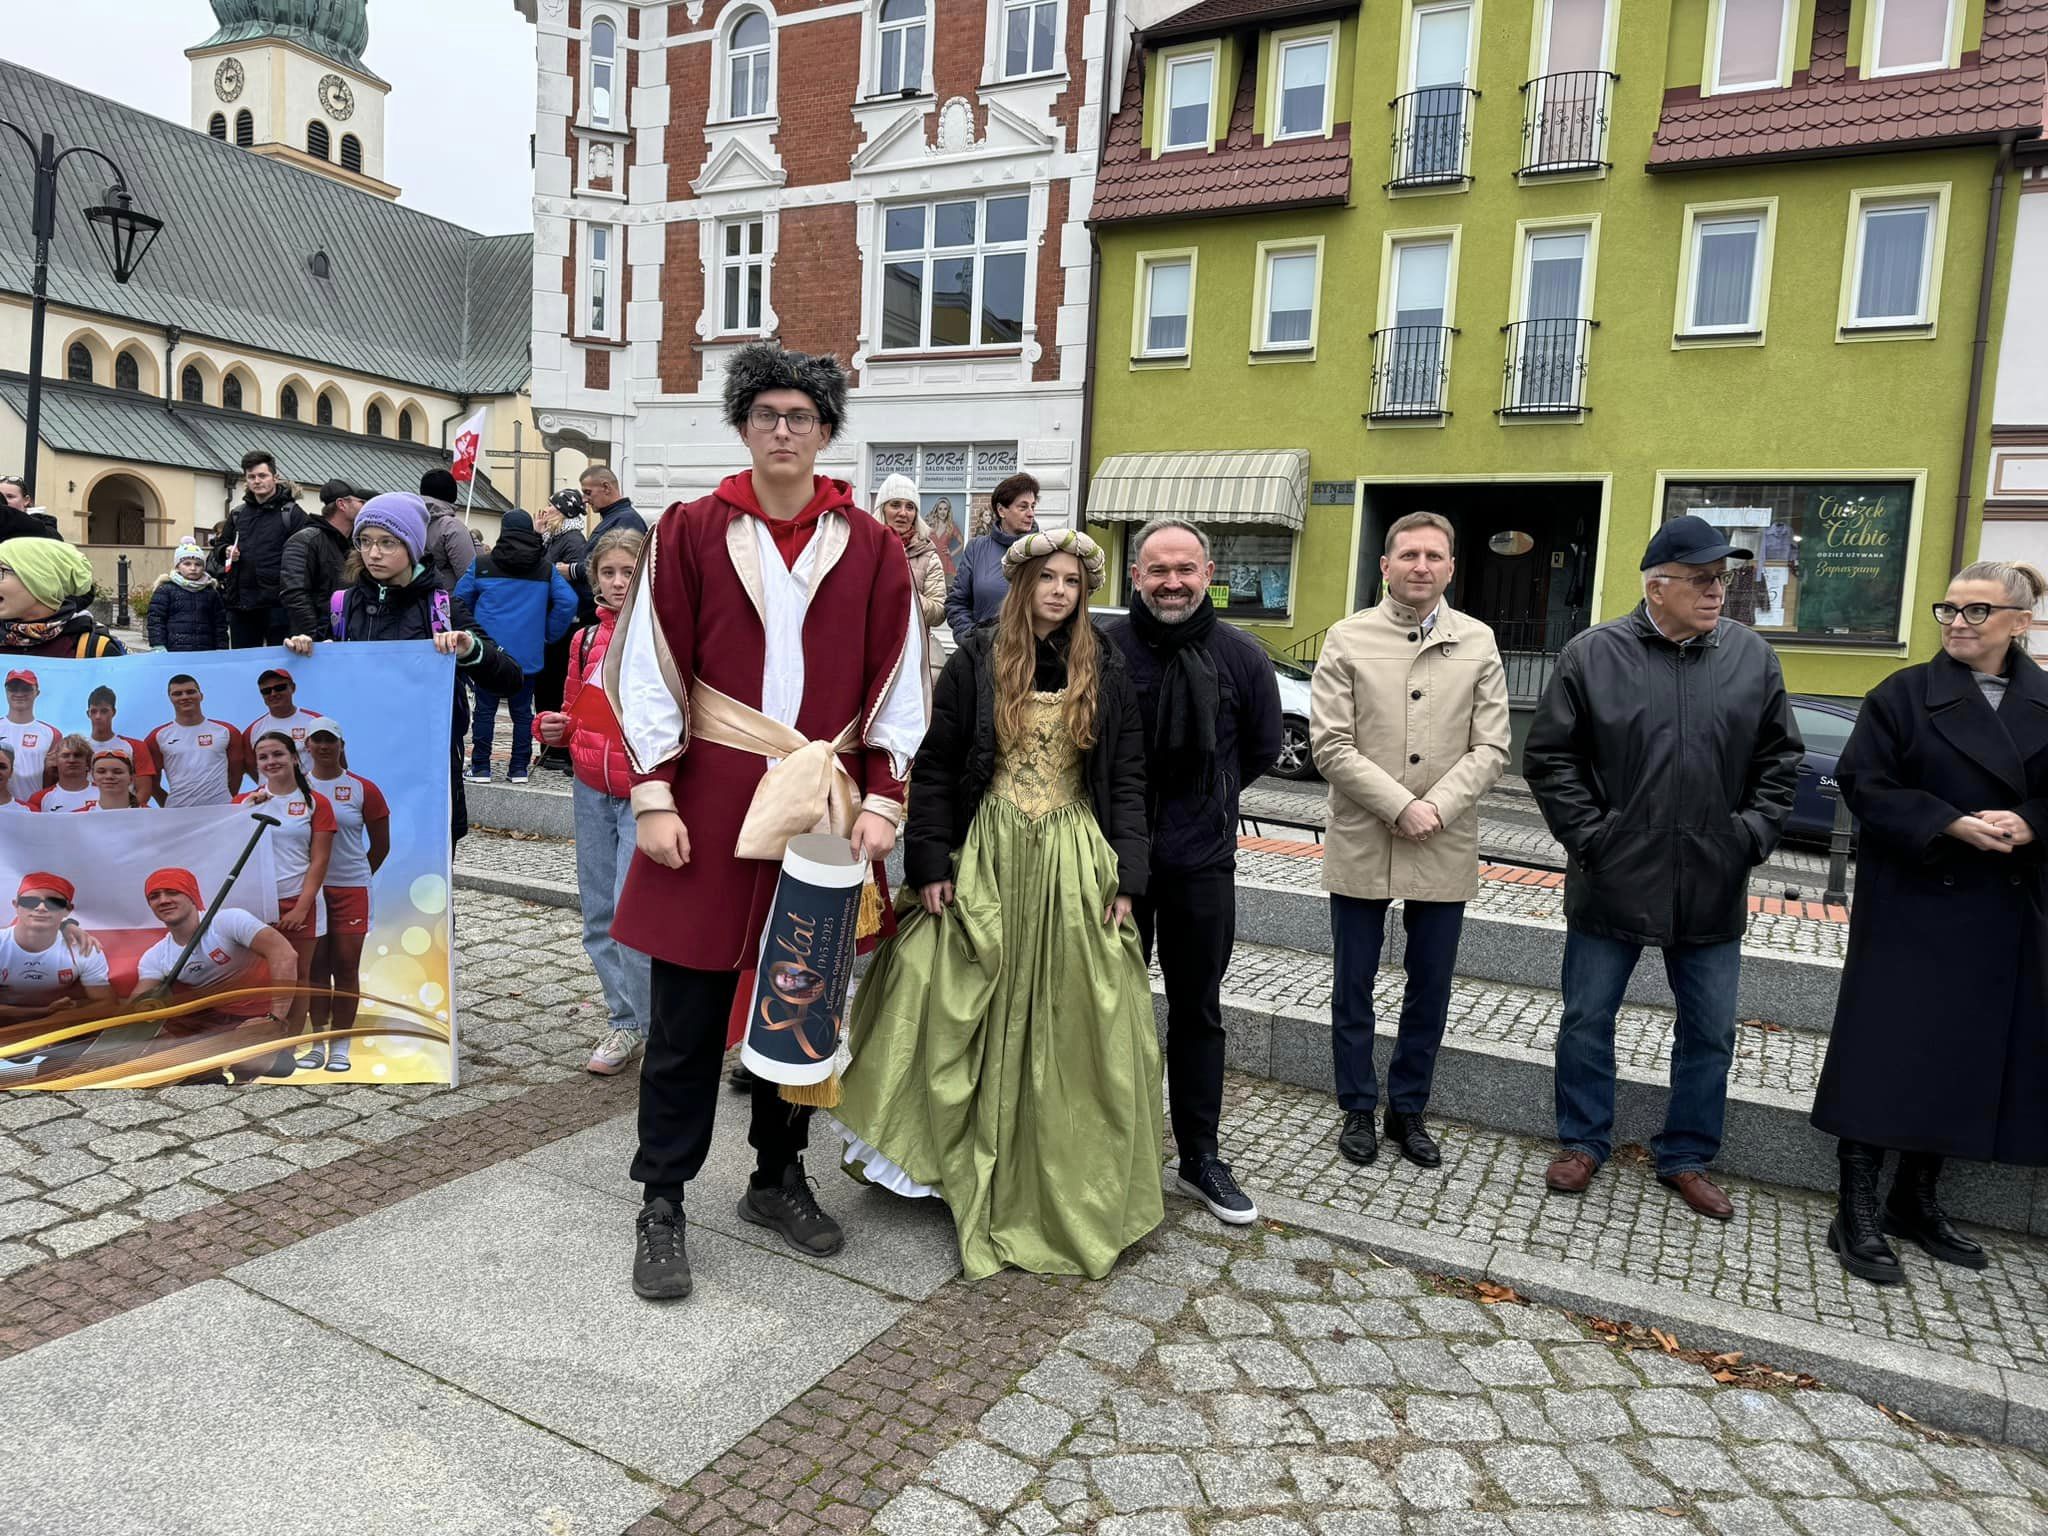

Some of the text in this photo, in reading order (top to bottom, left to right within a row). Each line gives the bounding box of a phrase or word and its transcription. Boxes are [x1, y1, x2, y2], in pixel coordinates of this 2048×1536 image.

[876, 453, 914, 466] DORA
[925, 452, 966, 466] DORA
[978, 451, 1018, 465] DORA
[1826, 519, 1890, 548] Ciebie
[1815, 560, 1880, 578] Zapraszamy
[776, 911, 817, 968] lat
[816, 916, 835, 970] 1945-2025
